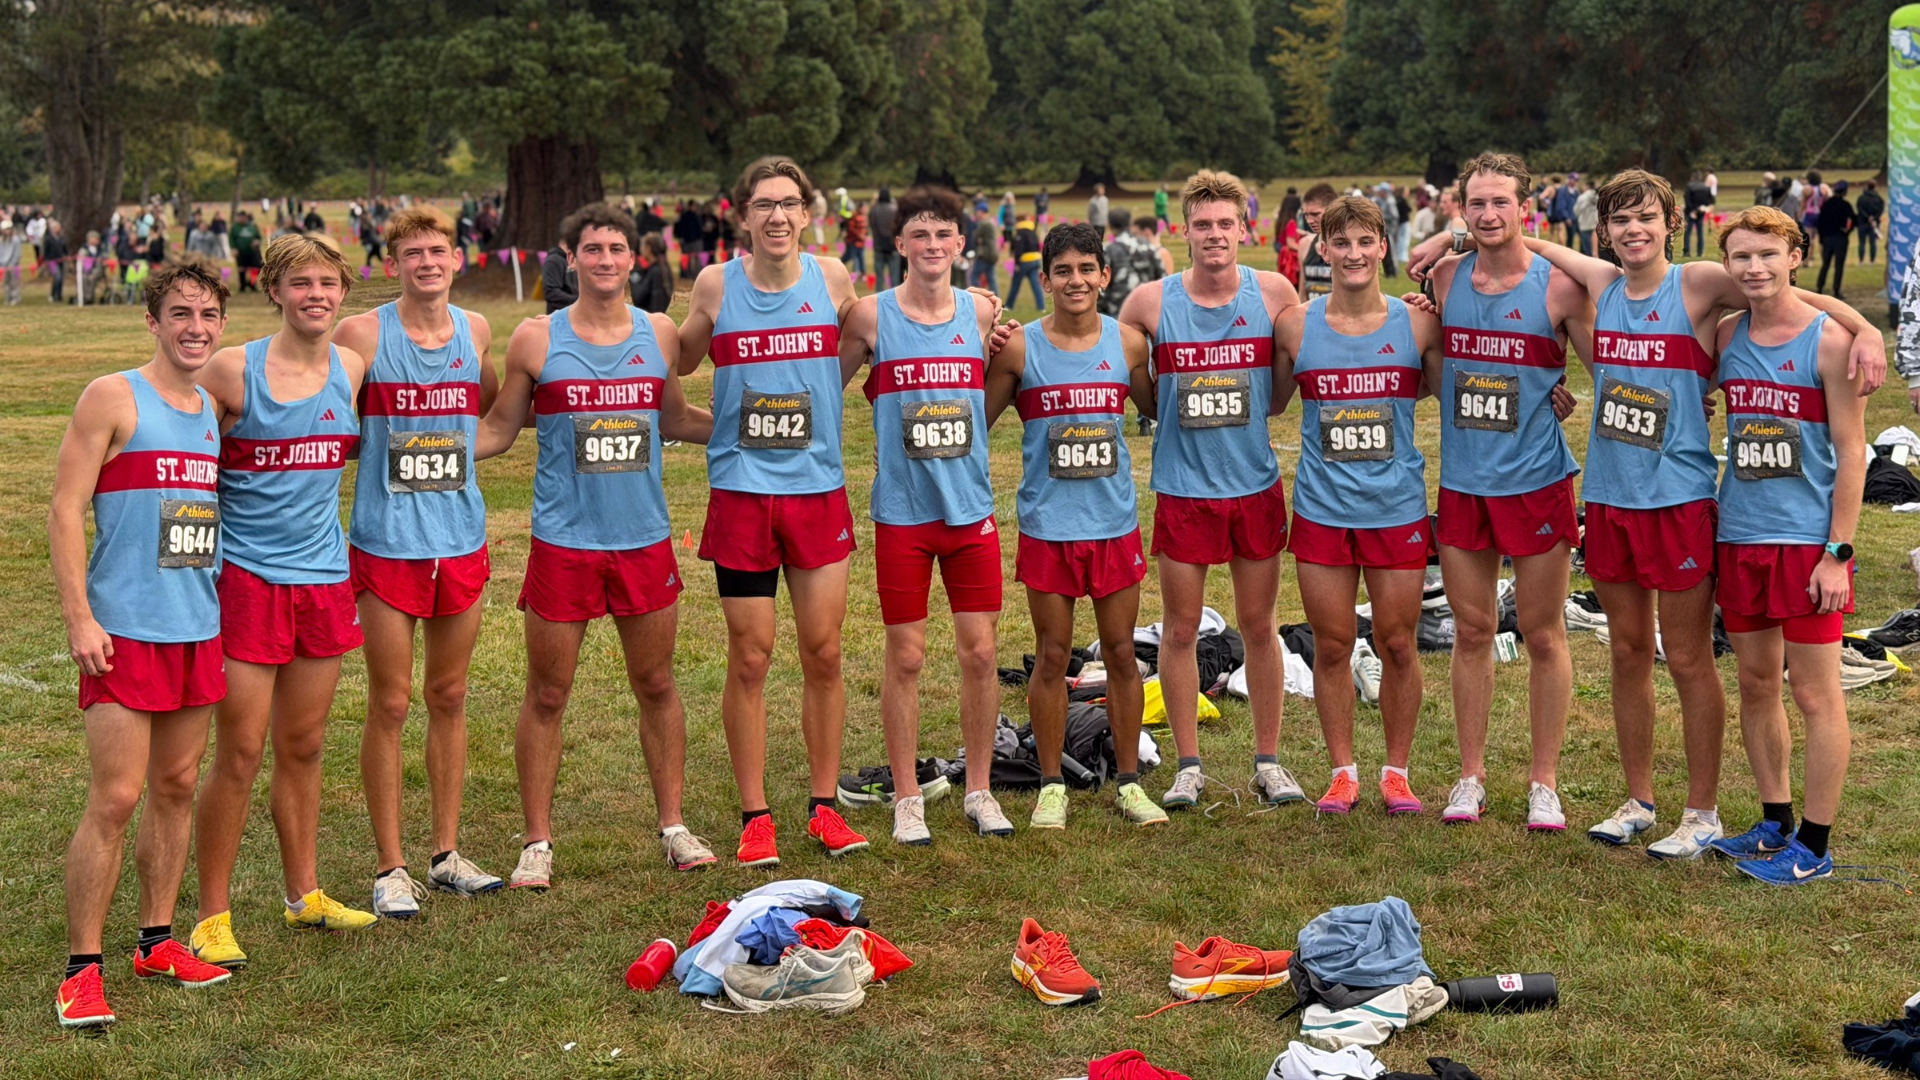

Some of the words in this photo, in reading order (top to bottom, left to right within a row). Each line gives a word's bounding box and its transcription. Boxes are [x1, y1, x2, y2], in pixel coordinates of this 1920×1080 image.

[738, 336, 762, 358] ST.
[764, 331, 823, 356] JOHN'S
[1175, 348, 1198, 367] ST.
[1200, 343, 1255, 366] JOHN'S
[1451, 333, 1470, 354] ST.
[1471, 336, 1525, 359] JOHN'S
[1611, 338, 1666, 362] JOHN'S
[894, 364, 917, 386] ST.
[918, 362, 972, 384] JOHN'S
[1191, 376, 1237, 388] Athletic
[1317, 374, 1341, 395] ST.
[1343, 372, 1400, 394] JOHN'S
[1465, 376, 1508, 390] Athletic
[396, 389, 418, 411] ST.
[567, 385, 592, 406] ST.
[594, 382, 653, 406] JOHN'S
[754, 397, 800, 409] Athletic
[1041, 390, 1064, 412] ST.
[1065, 387, 1118, 409] JOHN'S
[1187, 392, 1242, 417] 9635
[1461, 392, 1508, 420] 9641
[1610, 385, 1656, 404] Athletic
[1729, 385, 1748, 407] ST.
[916, 404, 961, 417] Athletic
[1333, 409, 1380, 421] Athletic
[1602, 400, 1657, 437] 9633
[589, 418, 638, 430] Athletic
[748, 413, 805, 437] 9642
[912, 420, 967, 447] 9638
[1061, 426, 1107, 438] Athletic
[1741, 423, 1785, 435] Athletic
[404, 436, 455, 448] Athletic
[585, 435, 642, 462] 9637
[1330, 425, 1386, 450] 9639
[255, 446, 280, 466] ST.
[283, 440, 341, 465] JOHN'S
[1057, 442, 1112, 468] 9643
[1737, 441, 1792, 468] 9640
[156, 457, 179, 481] ST.
[400, 453, 459, 480] 9634
[174, 504, 215, 518] Athletic
[169, 524, 215, 554] 9644
